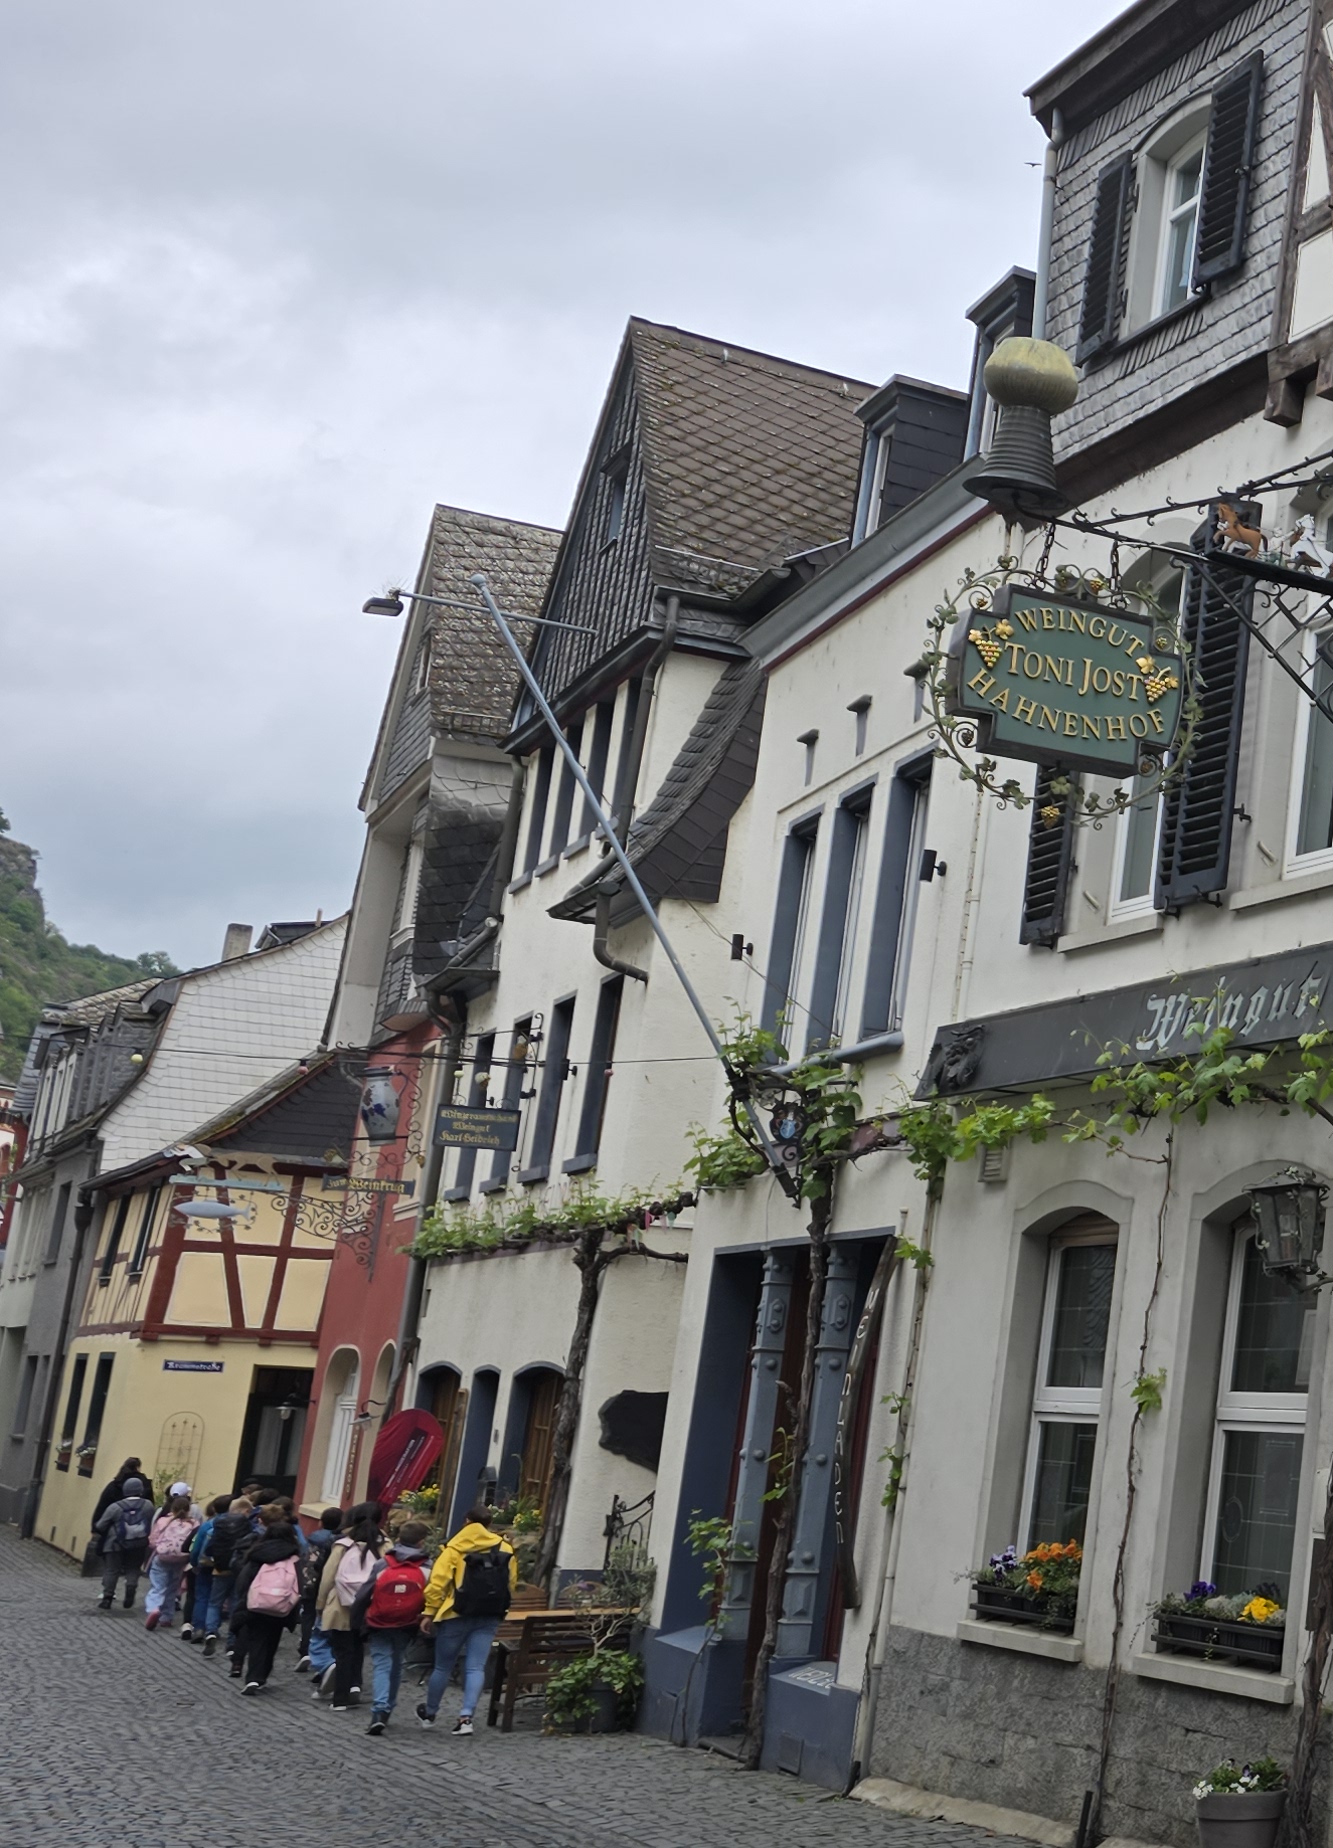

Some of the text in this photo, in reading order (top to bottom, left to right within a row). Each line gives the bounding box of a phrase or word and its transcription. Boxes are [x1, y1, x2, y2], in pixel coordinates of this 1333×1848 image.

[1014, 607, 1145, 658] WEINGUT
[1004, 641, 1144, 702] TONI JOST
[967, 667, 1167, 741] HAHNENHOF
[1136, 974, 1325, 1051] Weingut
[452, 1121, 490, 1133] Weingut
